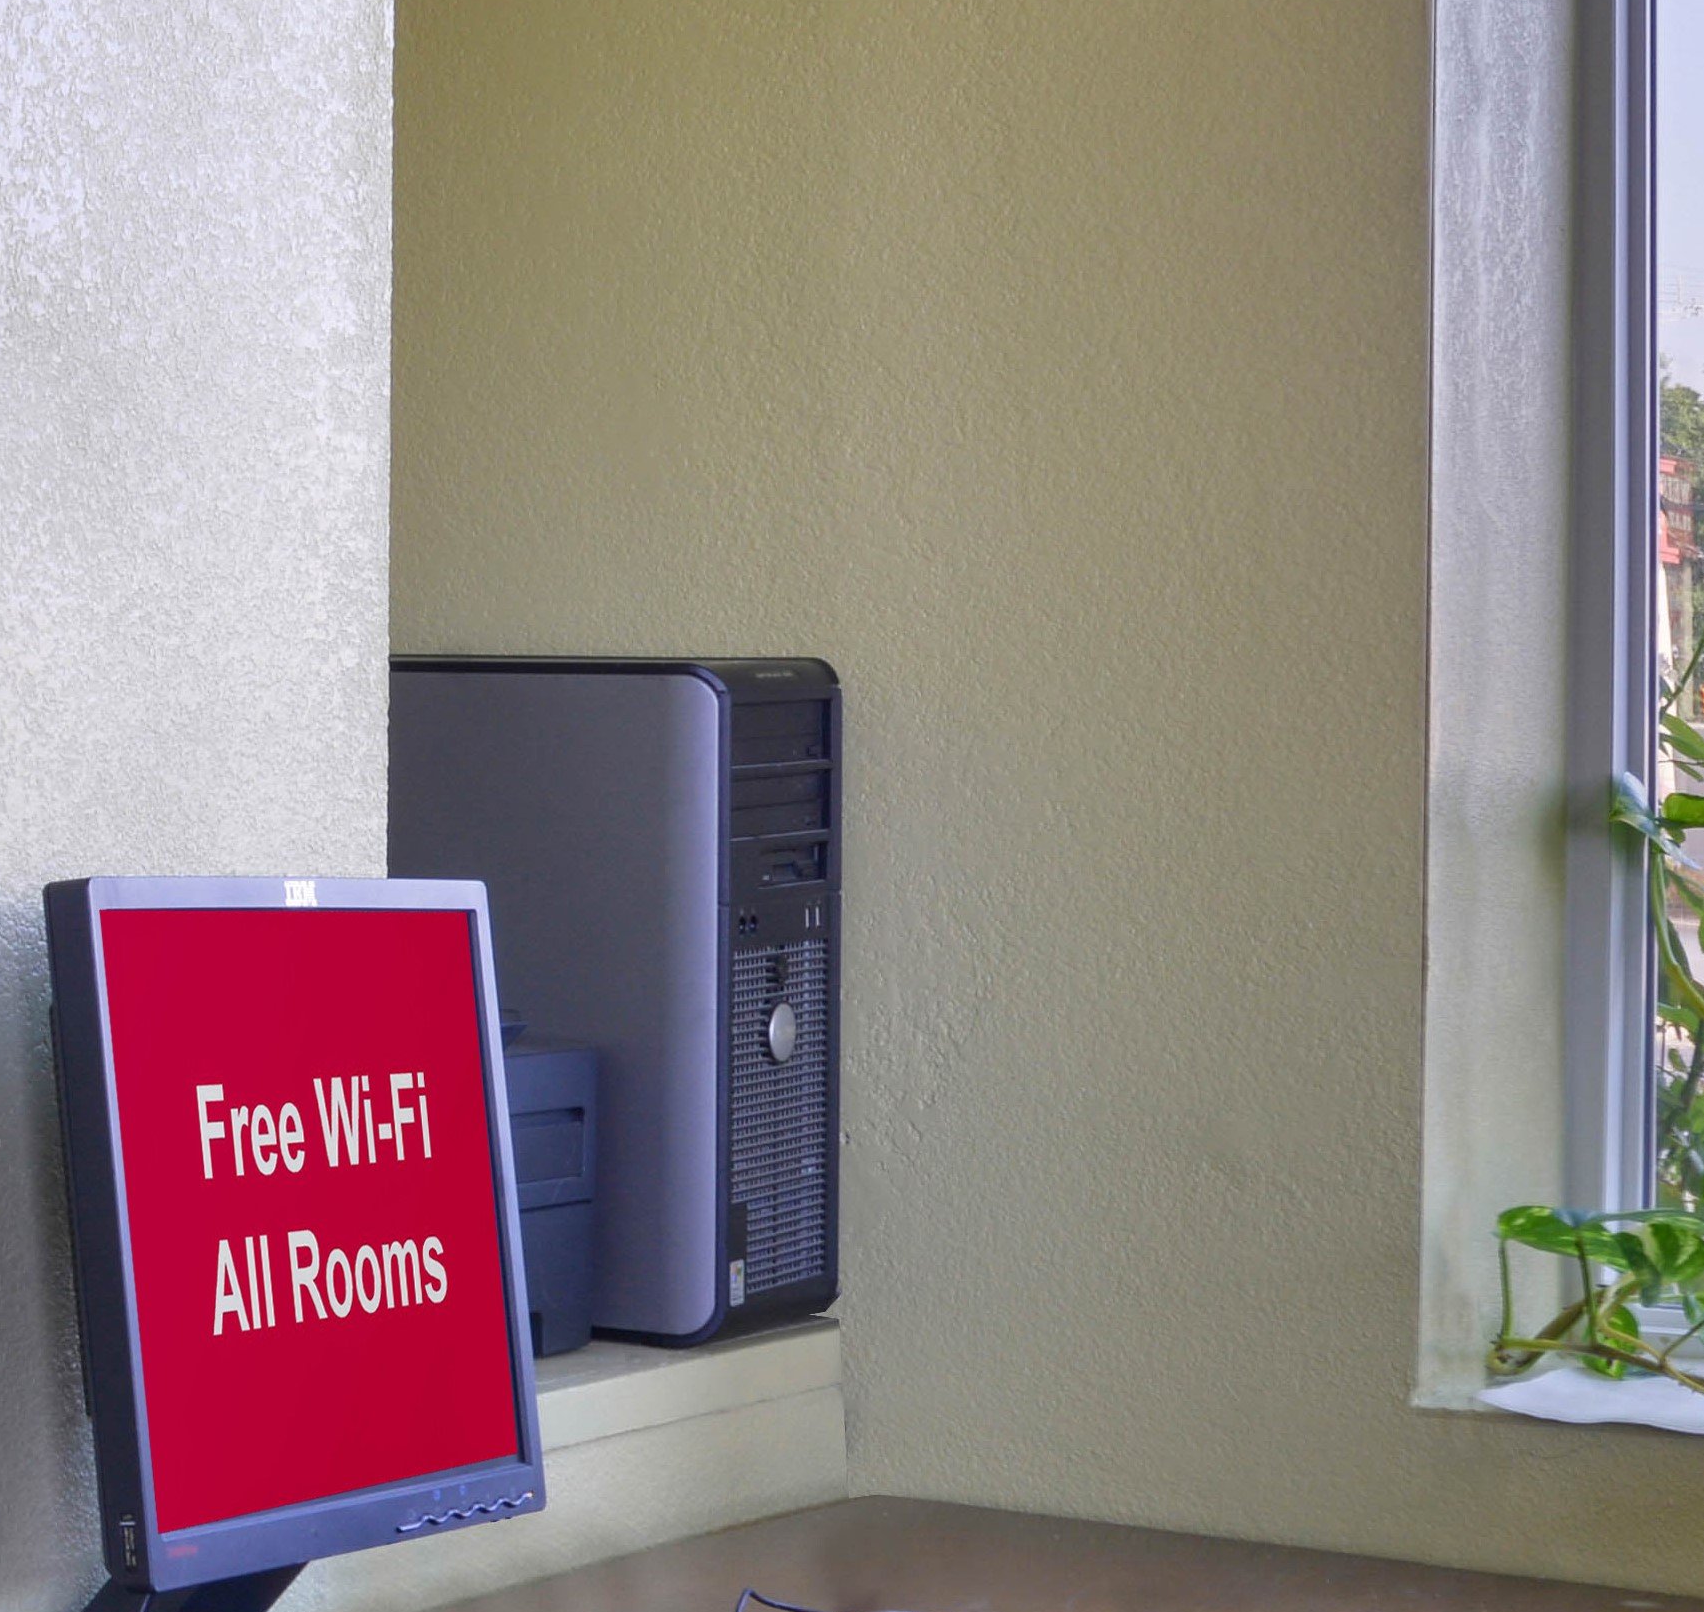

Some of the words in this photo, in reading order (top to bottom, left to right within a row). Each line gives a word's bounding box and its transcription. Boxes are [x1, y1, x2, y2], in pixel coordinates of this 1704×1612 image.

[196, 1084, 305, 1179] Free
[313, 1072, 432, 1167] Wi-Fi
[213, 1234, 276, 1336] All
[287, 1229, 448, 1323] Rooms
